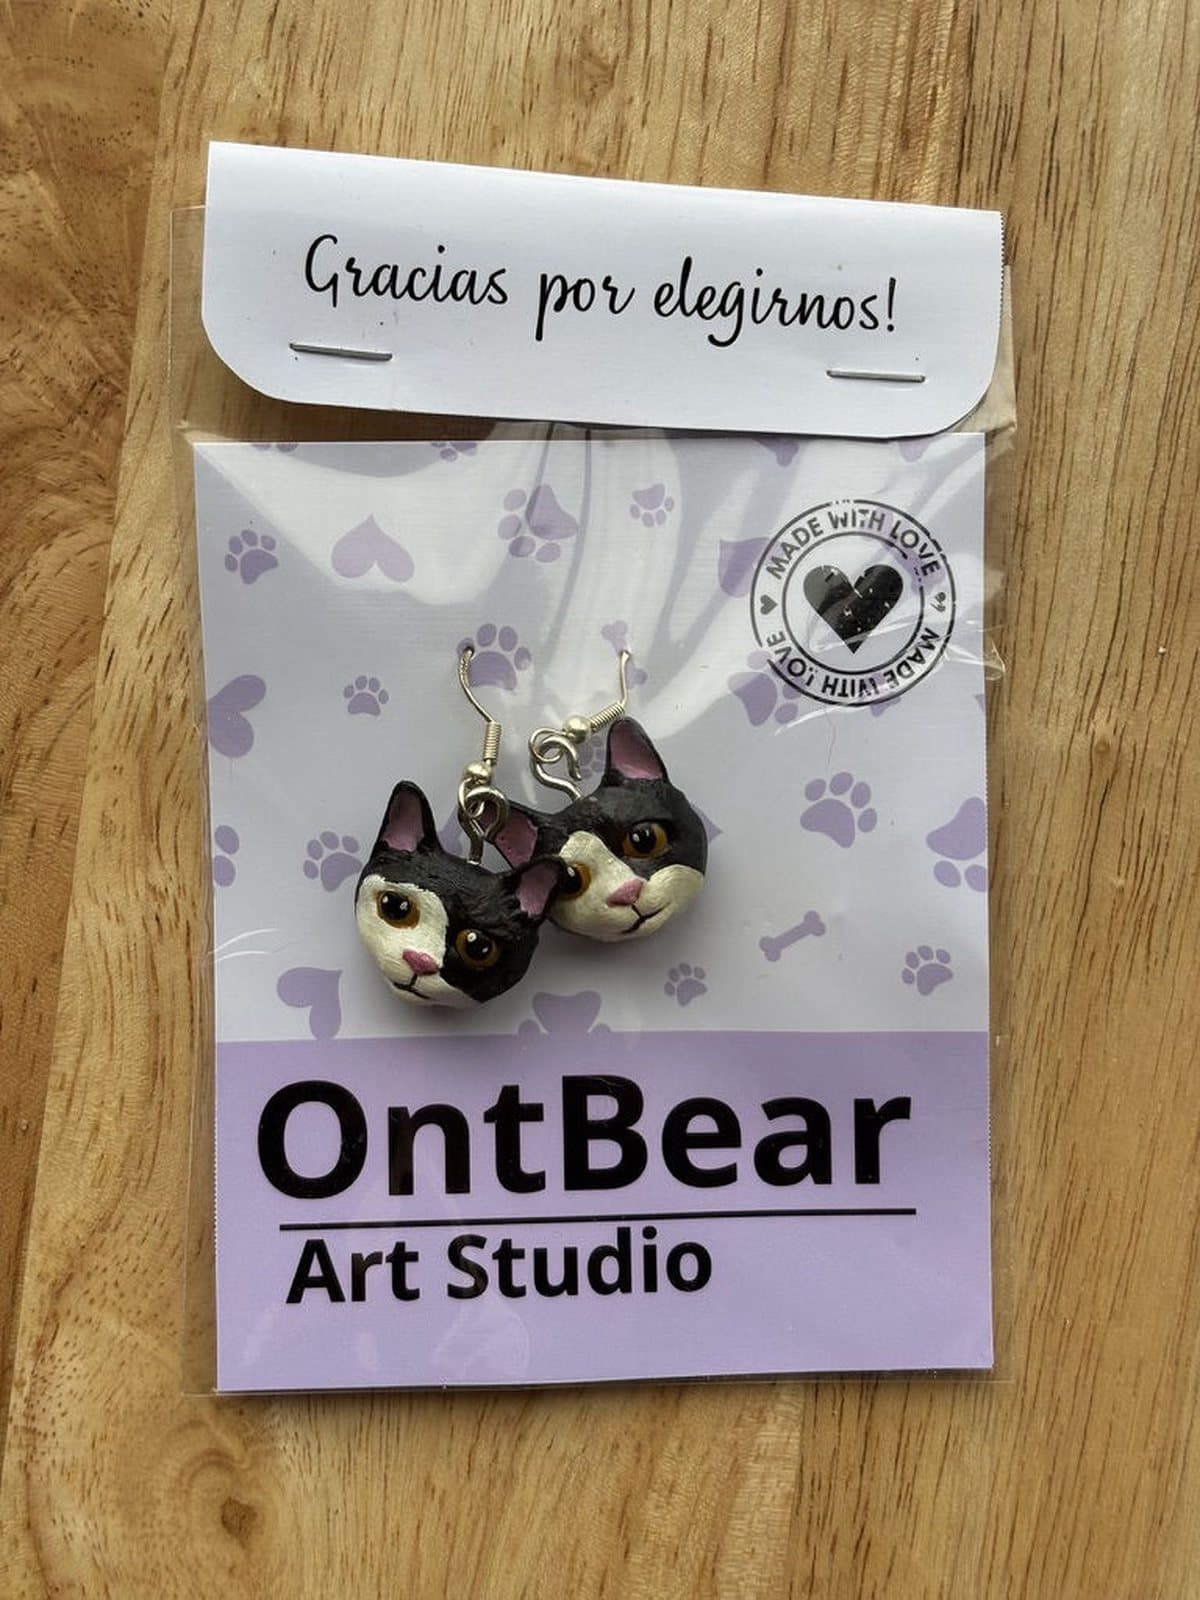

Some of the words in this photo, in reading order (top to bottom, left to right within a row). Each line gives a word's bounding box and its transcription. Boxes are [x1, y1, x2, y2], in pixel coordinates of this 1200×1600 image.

[304, 234, 508, 309] Gracias
[536, 267, 635, 341] por
[653, 257, 897, 347] elegirnos!
[766, 517, 824, 580] MADE
[827, 509, 885, 532] WITH
[890, 520, 941, 577] LOVE
[766, 631, 815, 688] LOVE
[821, 675, 880, 698] WITH
[883, 627, 940, 689] MADE
[257, 1075, 911, 1200] OntBear
[285, 1238, 420, 1305] Art
[446, 1226, 713, 1300] Studio
